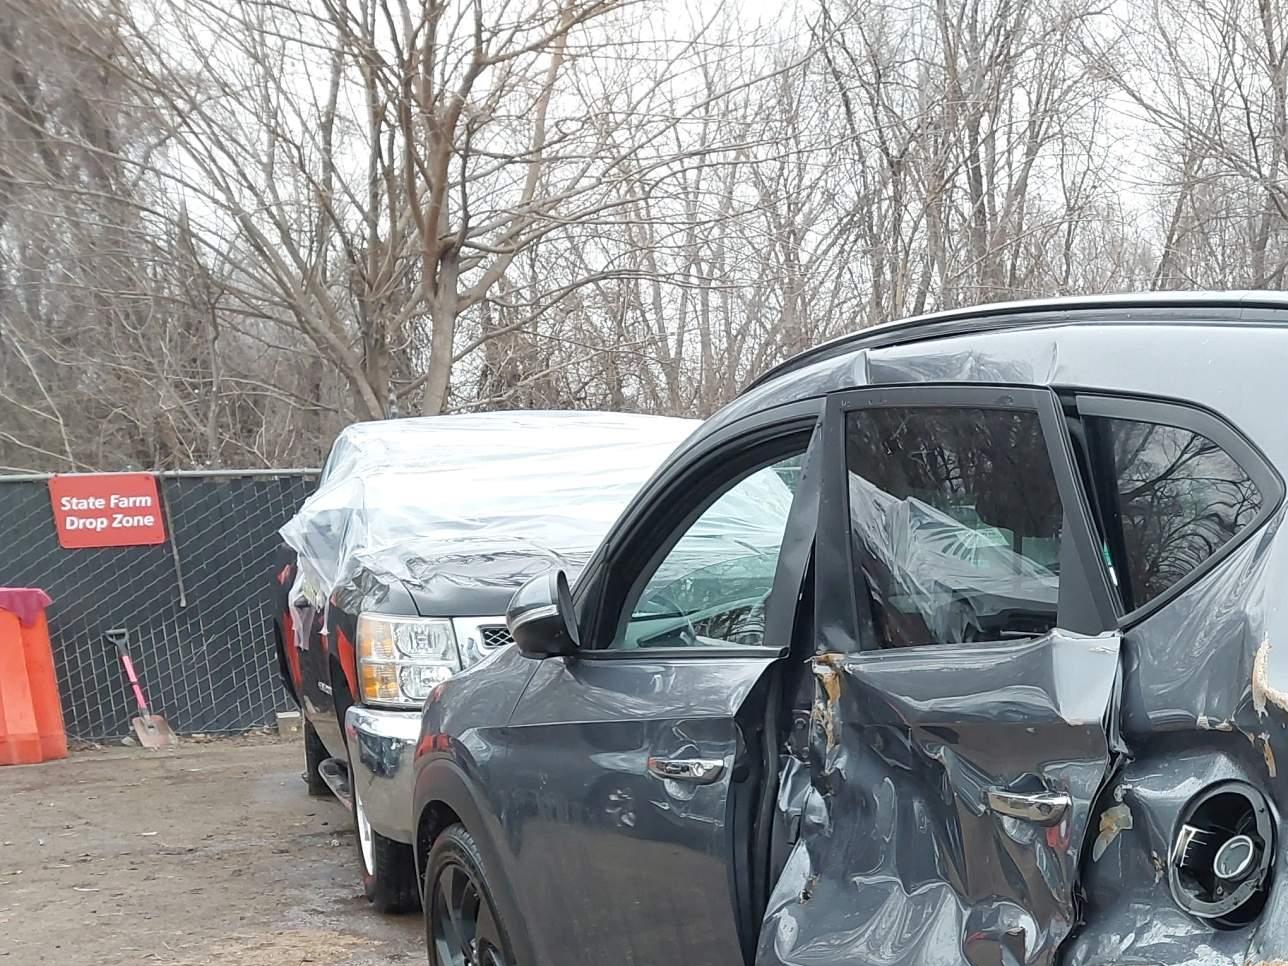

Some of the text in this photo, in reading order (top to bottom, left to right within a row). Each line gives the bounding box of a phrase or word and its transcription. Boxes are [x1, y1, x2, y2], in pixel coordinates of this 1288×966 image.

[61, 495, 151, 511] State Farm
[65, 514, 155, 532] Drop Zone
